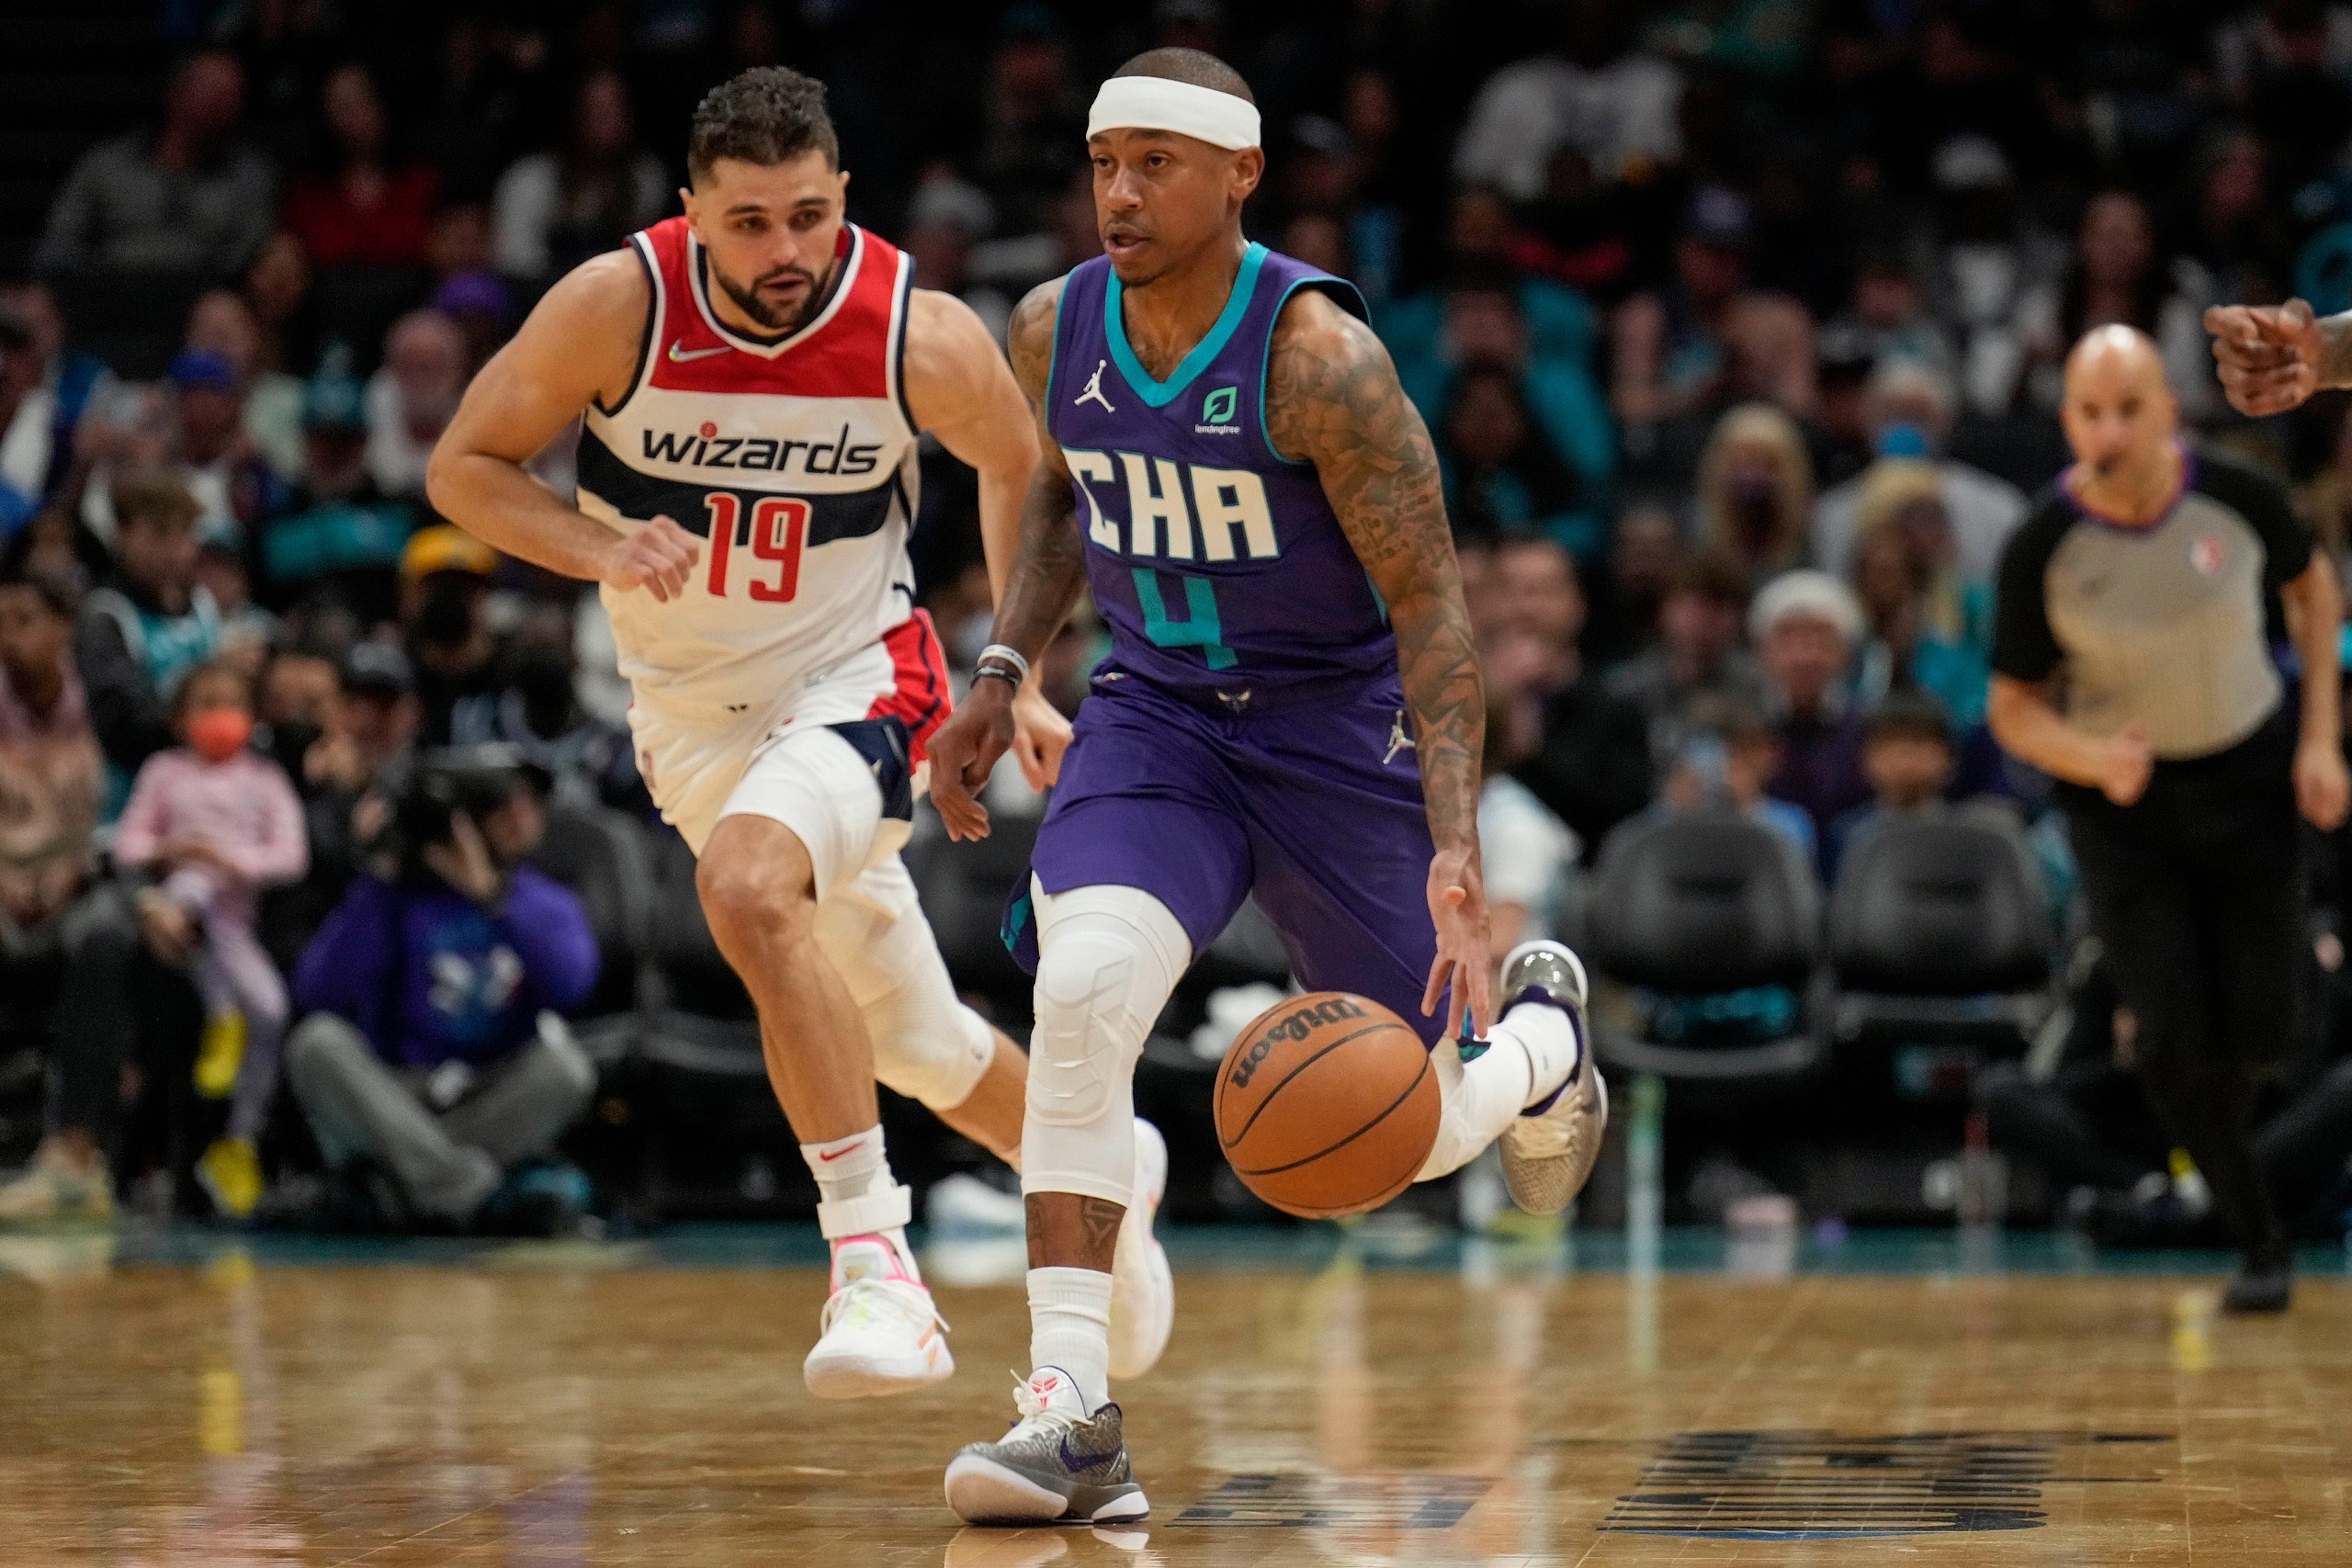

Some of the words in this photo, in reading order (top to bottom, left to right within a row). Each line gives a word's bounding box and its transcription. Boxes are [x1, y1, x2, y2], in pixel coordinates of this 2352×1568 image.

[642, 421, 886, 475] wizards
[705, 492, 812, 604] 19
[1062, 447, 1282, 563] CHA
[1131, 567, 1239, 671] 4
